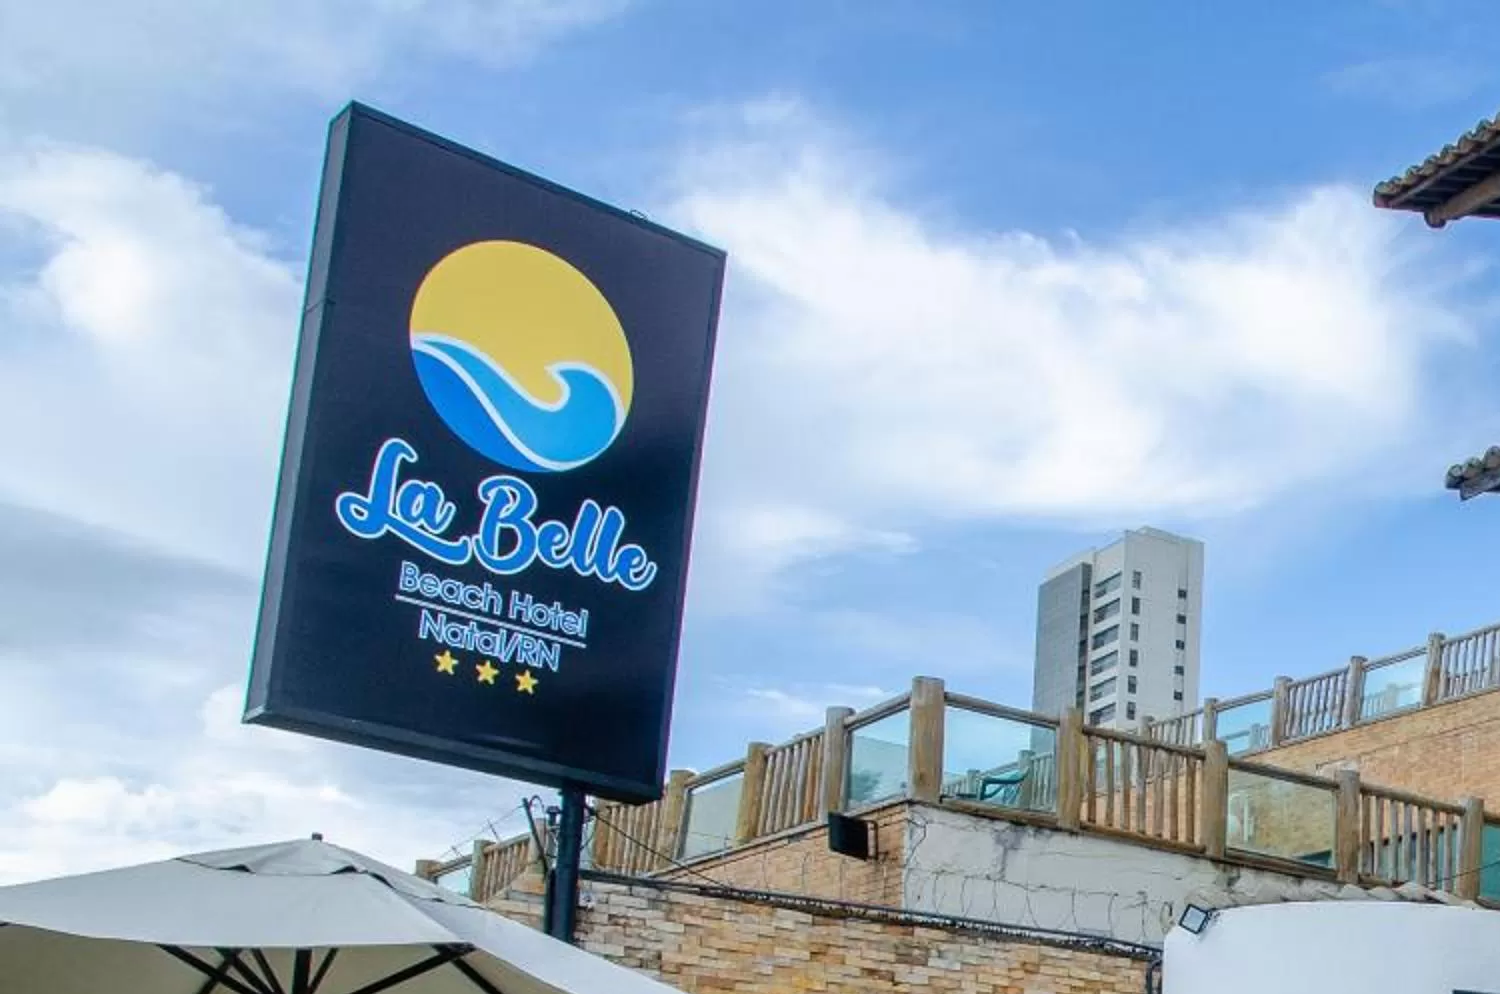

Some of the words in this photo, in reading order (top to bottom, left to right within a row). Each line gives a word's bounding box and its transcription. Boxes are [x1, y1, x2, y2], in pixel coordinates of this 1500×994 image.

[336, 437, 472, 566] La
[473, 474, 658, 591] Belle
[399, 560, 503, 616] Beach
[509, 589, 589, 638] Hotel
[418, 608, 561, 673] Natal/RN
